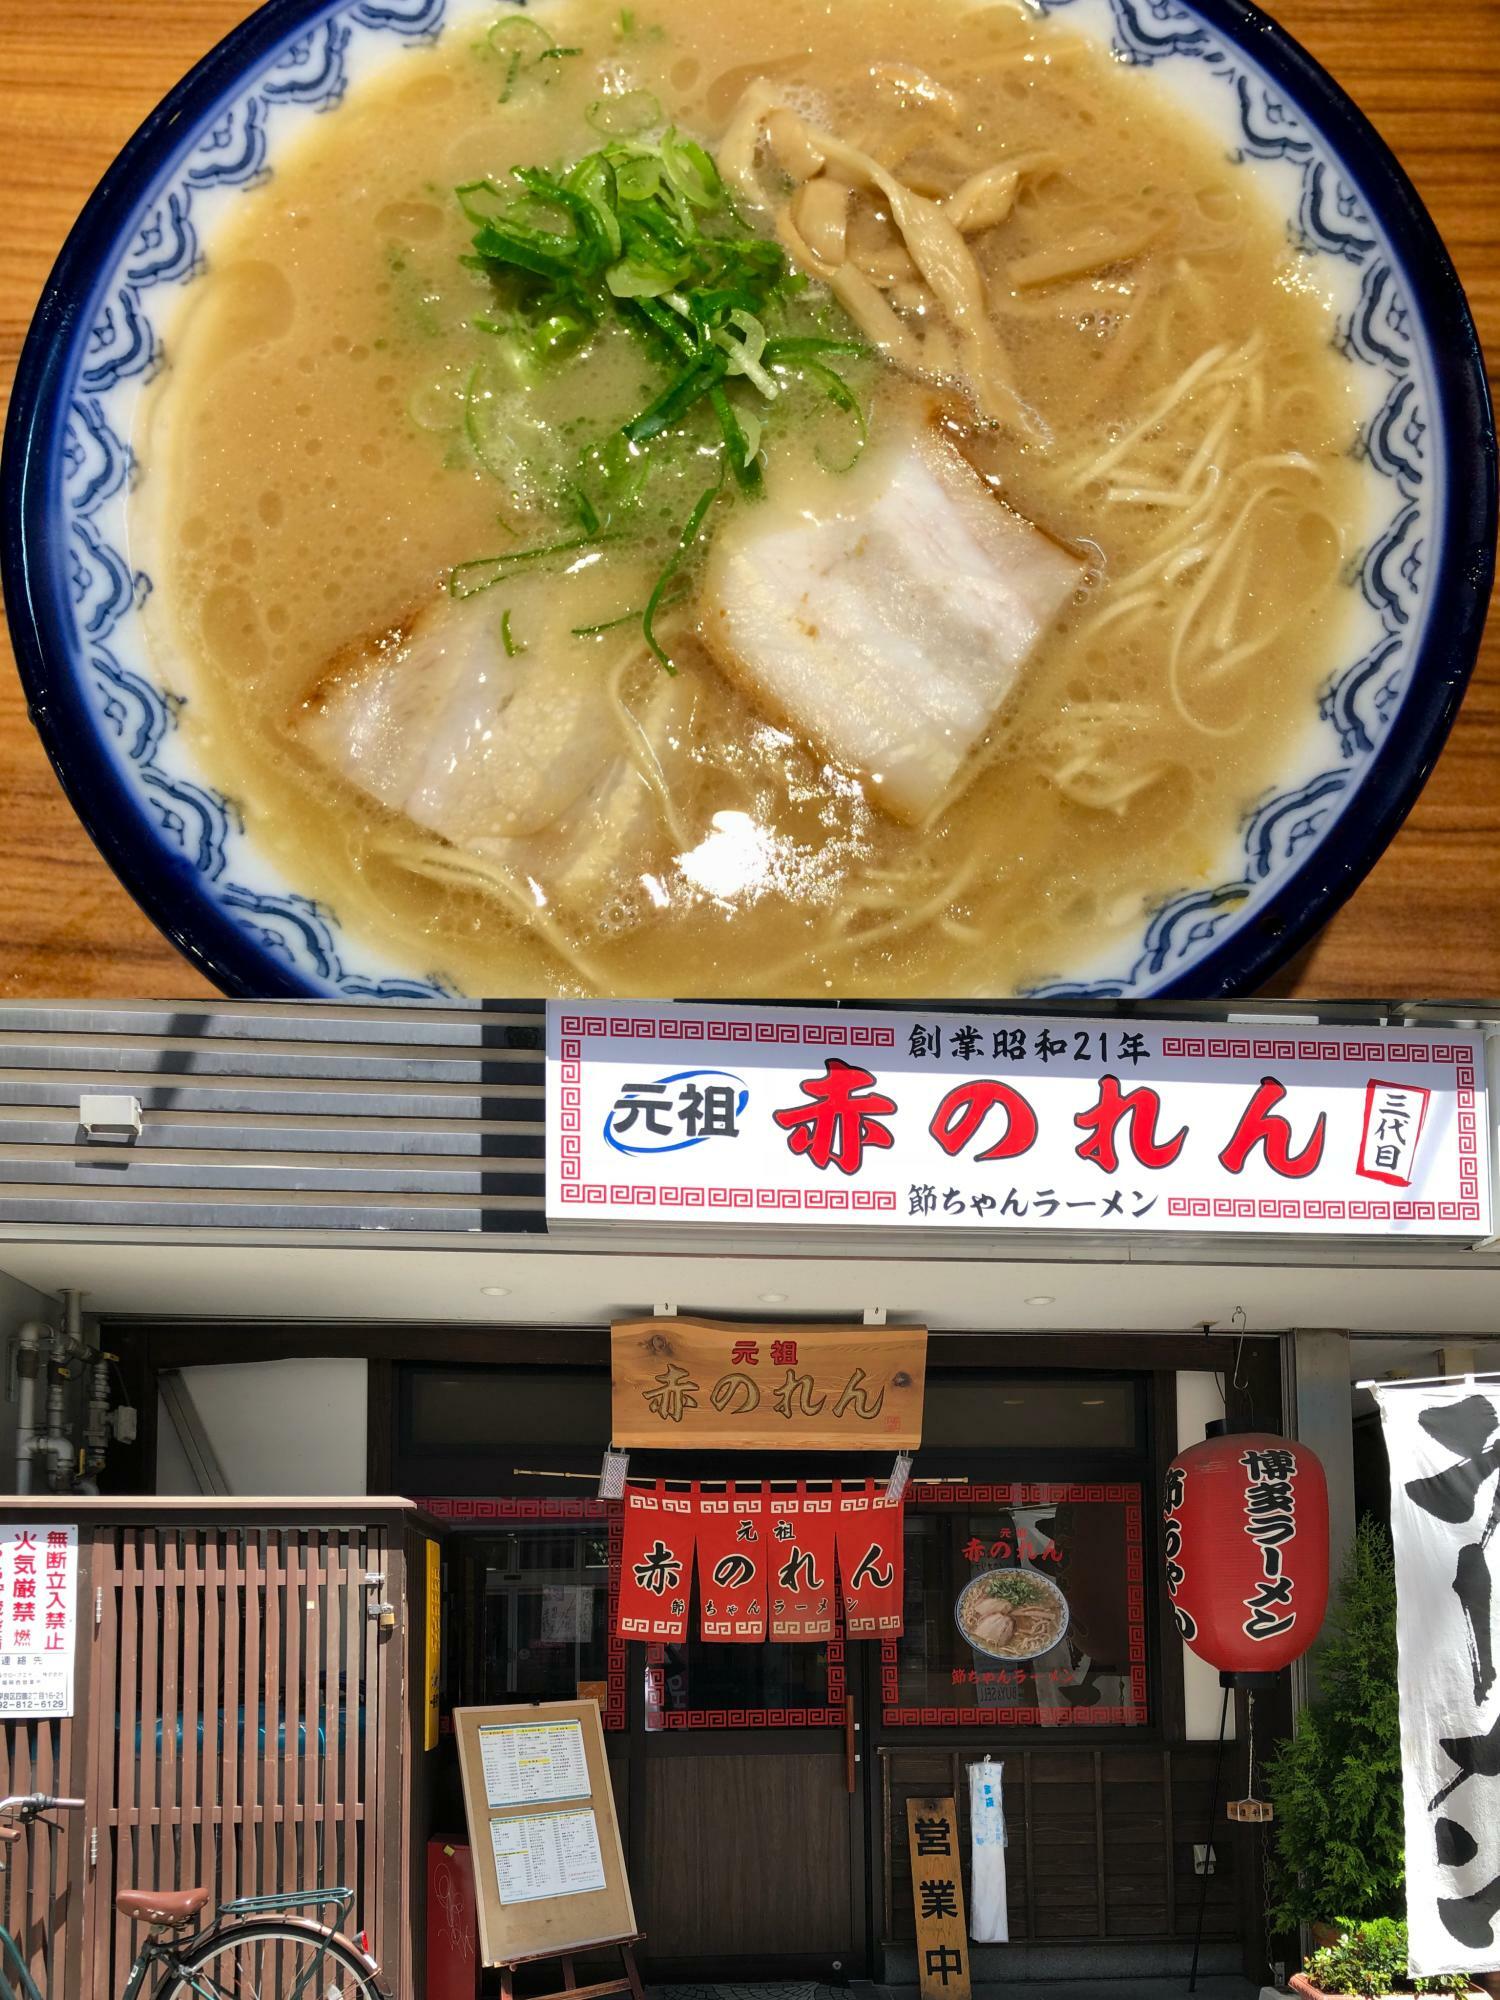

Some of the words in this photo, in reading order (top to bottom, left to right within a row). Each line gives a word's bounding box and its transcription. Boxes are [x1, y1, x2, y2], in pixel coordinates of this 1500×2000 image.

[908, 1024, 1151, 1066] 創業昭和21年
[613, 1083, 740, 1138] 元祖
[774, 1058, 1327, 1178] 赤のれん
[1374, 1093, 1411, 1171] 三代目
[907, 1184, 1159, 1218] 節ちゃんラーメン
[732, 1340, 798, 1365] 元祖
[643, 1363, 885, 1422] 赤のれん
[736, 1520, 795, 1542] 元祖
[961, 1537, 1063, 1562] 赤のれん
[1238, 1449, 1298, 1641] 博多ラーメン
[13, 1531, 37, 1622] 火気厳禁
[44, 1531, 68, 1650] 無断立入禁止
[634, 1540, 894, 1596] 赤のれん
[671, 1598, 859, 1616] 節ちゃんラーメン
[951, 1667, 1076, 1685] 節ちゃんラーメン
[915, 1818, 962, 1985] 営業中
